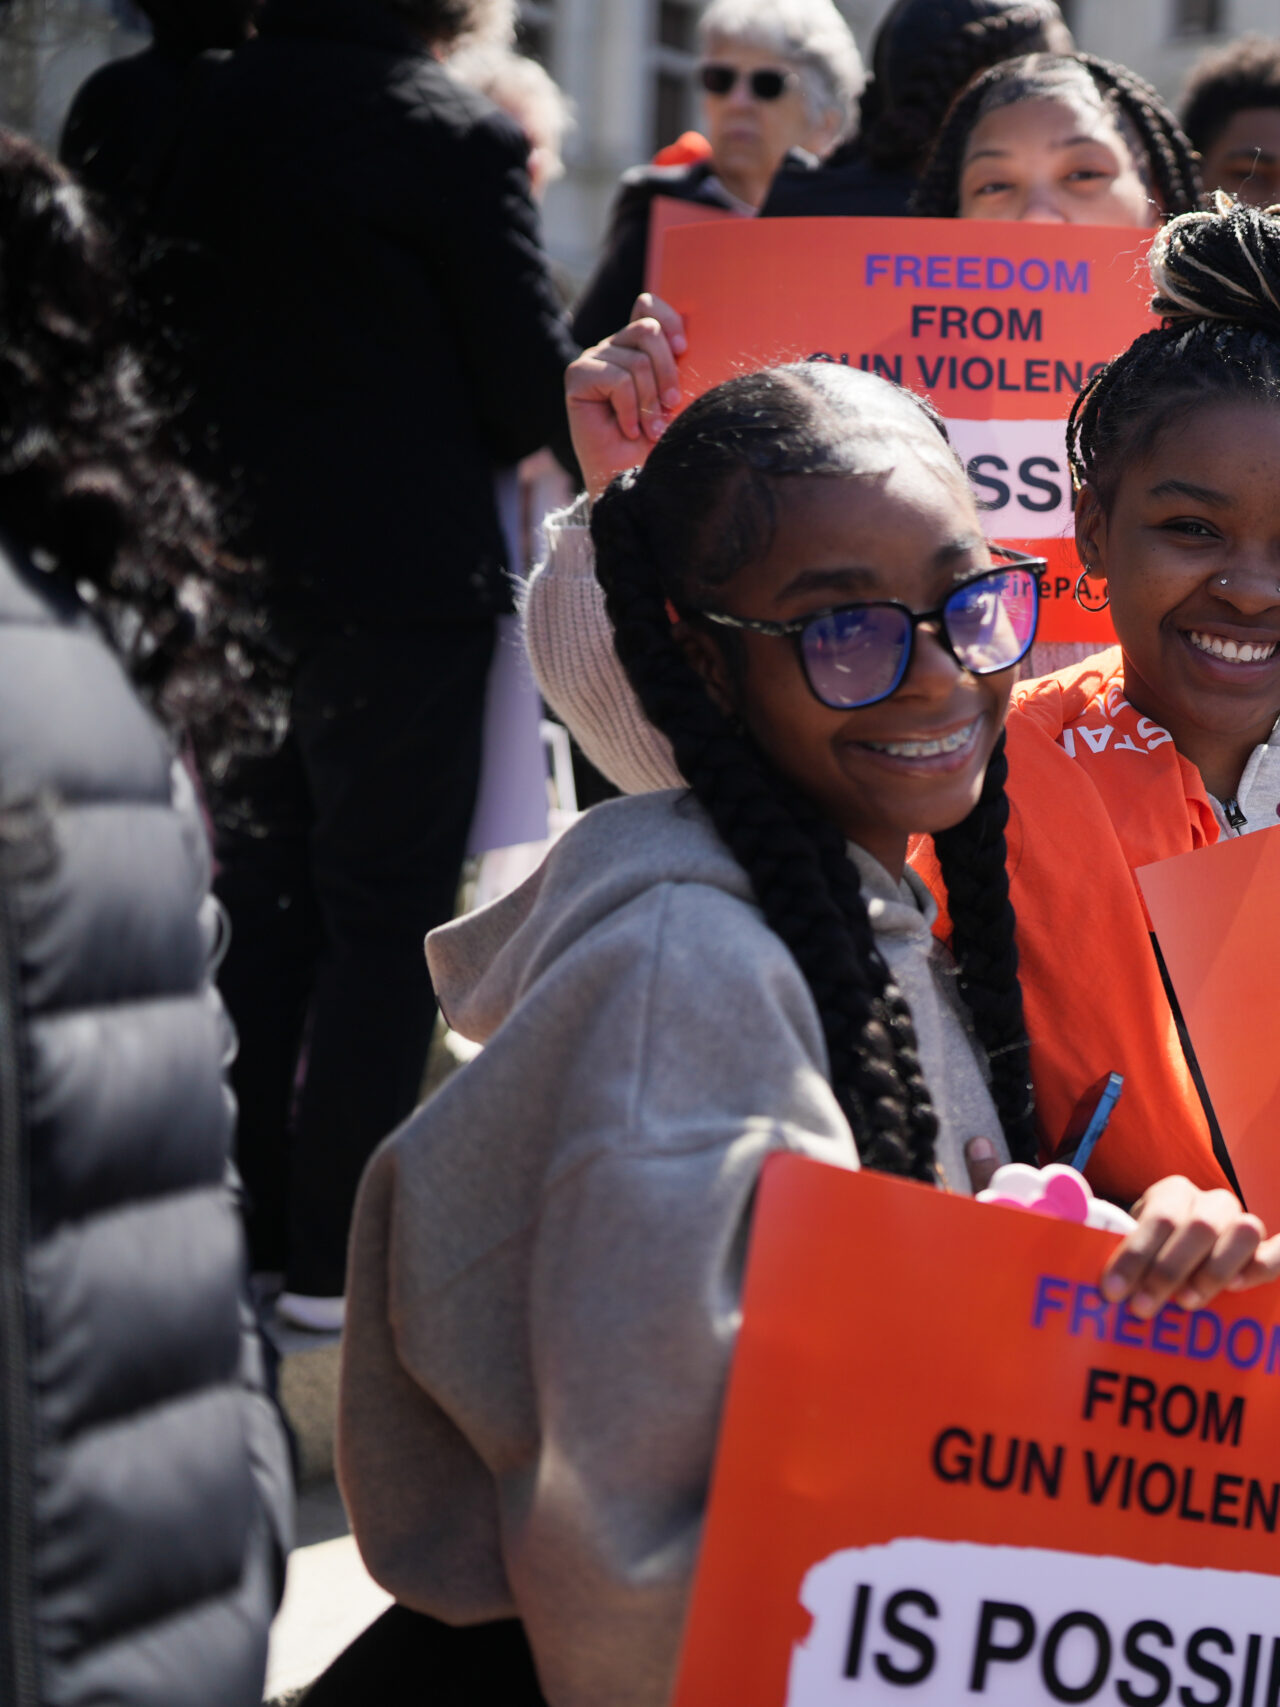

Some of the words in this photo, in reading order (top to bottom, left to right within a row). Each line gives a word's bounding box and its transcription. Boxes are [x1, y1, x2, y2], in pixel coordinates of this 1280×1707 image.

[865, 254, 1089, 294] FREEDOM
[911, 305, 1042, 342] FROM
[1082, 1366, 1246, 1448] FROM
[930, 1425, 1066, 1500] GUN
[841, 1582, 942, 1690] IS
